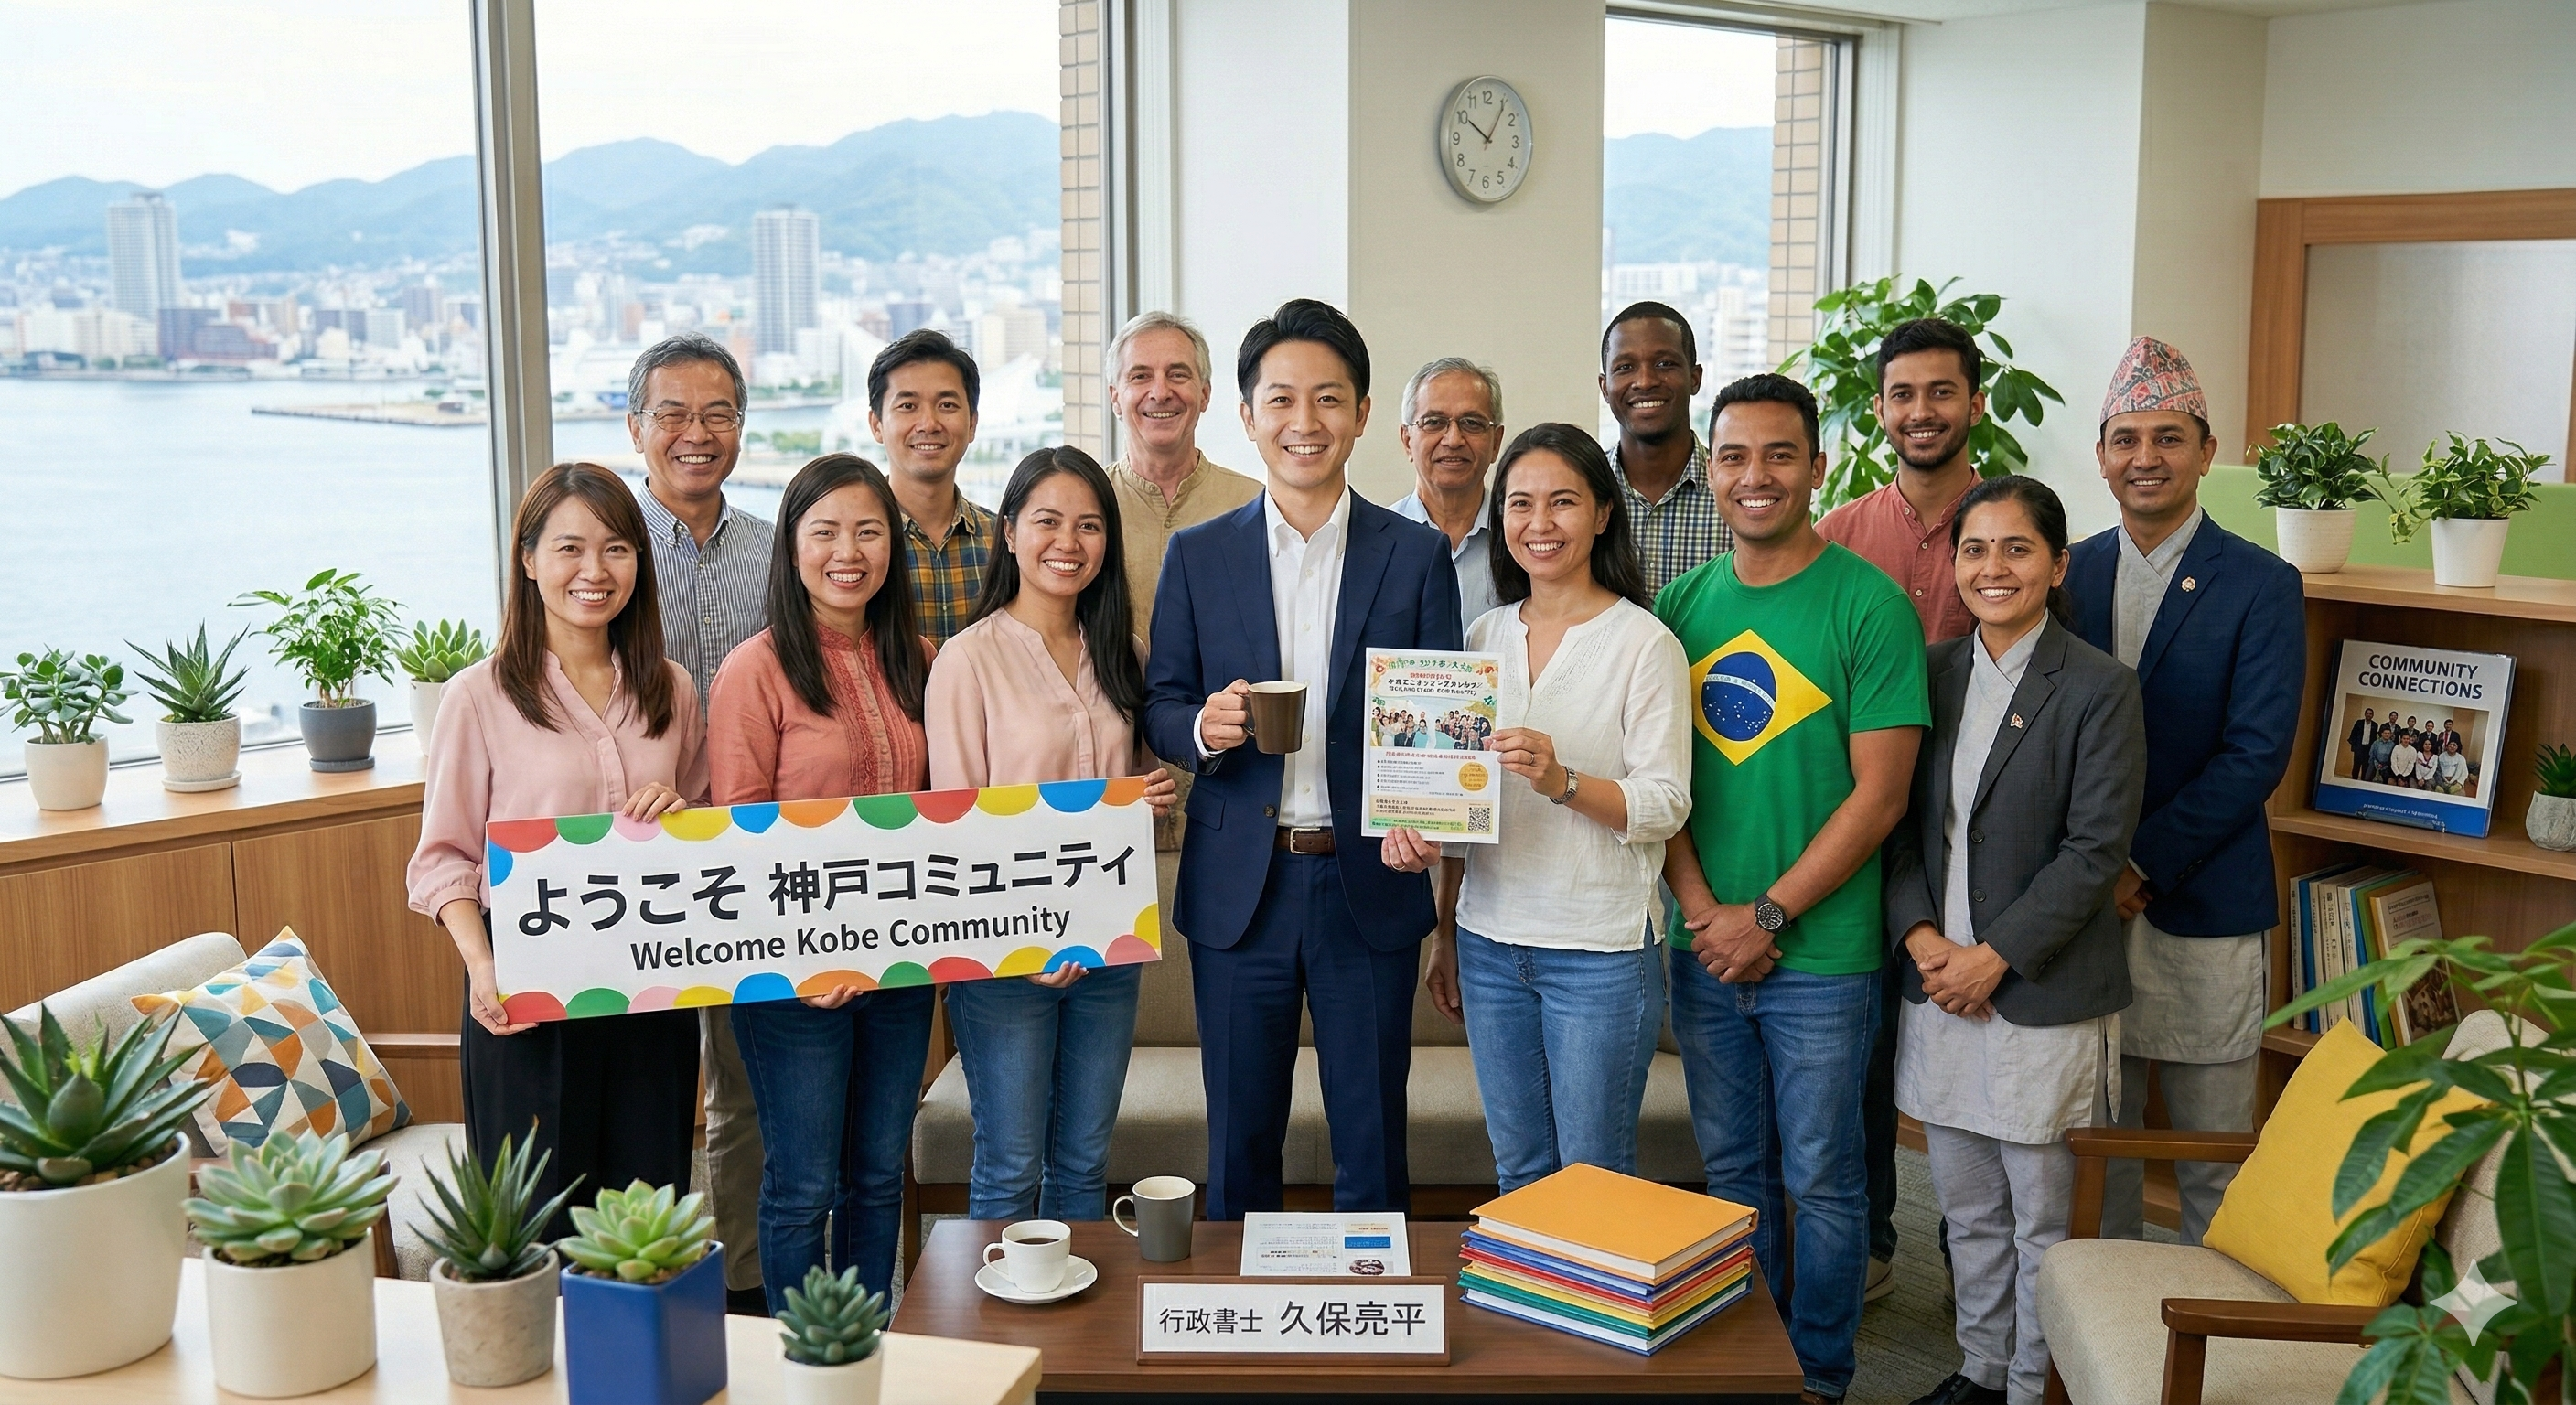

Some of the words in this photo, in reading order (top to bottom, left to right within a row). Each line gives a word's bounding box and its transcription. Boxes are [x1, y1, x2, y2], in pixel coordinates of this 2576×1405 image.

[1467, 94, 1477, 109] 11
[1482, 91, 1493, 105] 12
[1456, 110, 1468, 124] 10
[1508, 113, 1516, 127] 2
[1453, 131, 1461, 145] 9
[1511, 134, 1519, 149] 3
[1456, 153, 1465, 167] 8
[1507, 156, 1515, 169] 4
[1468, 169, 1476, 184] 7
[1482, 175, 1490, 189] 6
[1497, 170, 1505, 185] 5
[2368, 653, 2479, 680] COMMUNITY
[2358, 670, 2483, 700] CONNECTIONS
[518, 865, 746, 937] ようこそ
[768, 842, 1136, 917] 神戸コミュニティ
[630, 938, 786, 971] Welcome
[797, 923, 880, 956] Kobe
[889, 906, 1071, 947] Community
[1159, 1308, 1263, 1335] 行政書士
[1280, 1300, 1426, 1336] 久保亮平
